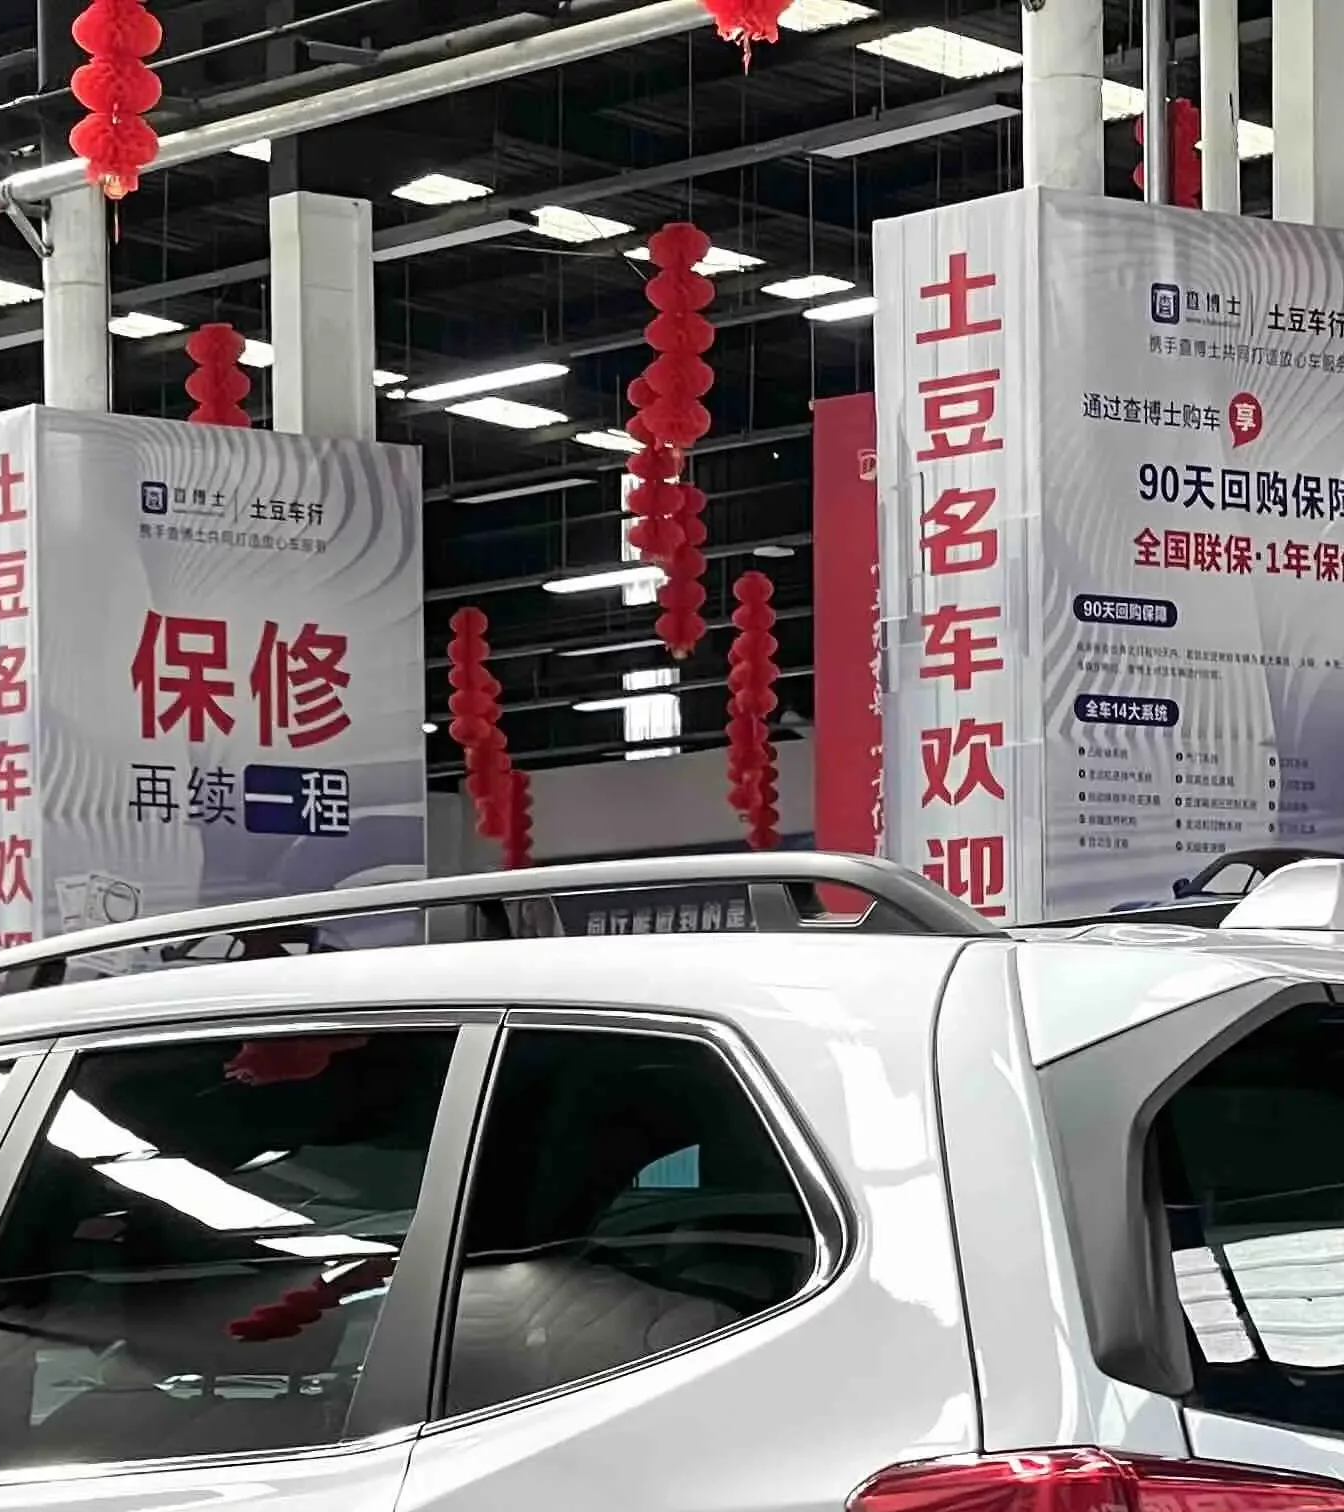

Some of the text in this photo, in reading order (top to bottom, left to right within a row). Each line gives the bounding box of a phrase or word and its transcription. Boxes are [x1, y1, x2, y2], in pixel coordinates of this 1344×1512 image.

[1082, 392, 1257, 431] 通过查博士购车 享
[250, 498, 324, 525] 土豆车行
[916, 252, 1006, 917] 土豆名车欢迎
[1083, 600, 1167, 624] 90天回购保障
[130, 610, 351, 748] 保修
[1085, 700, 1168, 723] 全车14大系统
[129, 763, 350, 834] 再续一程
